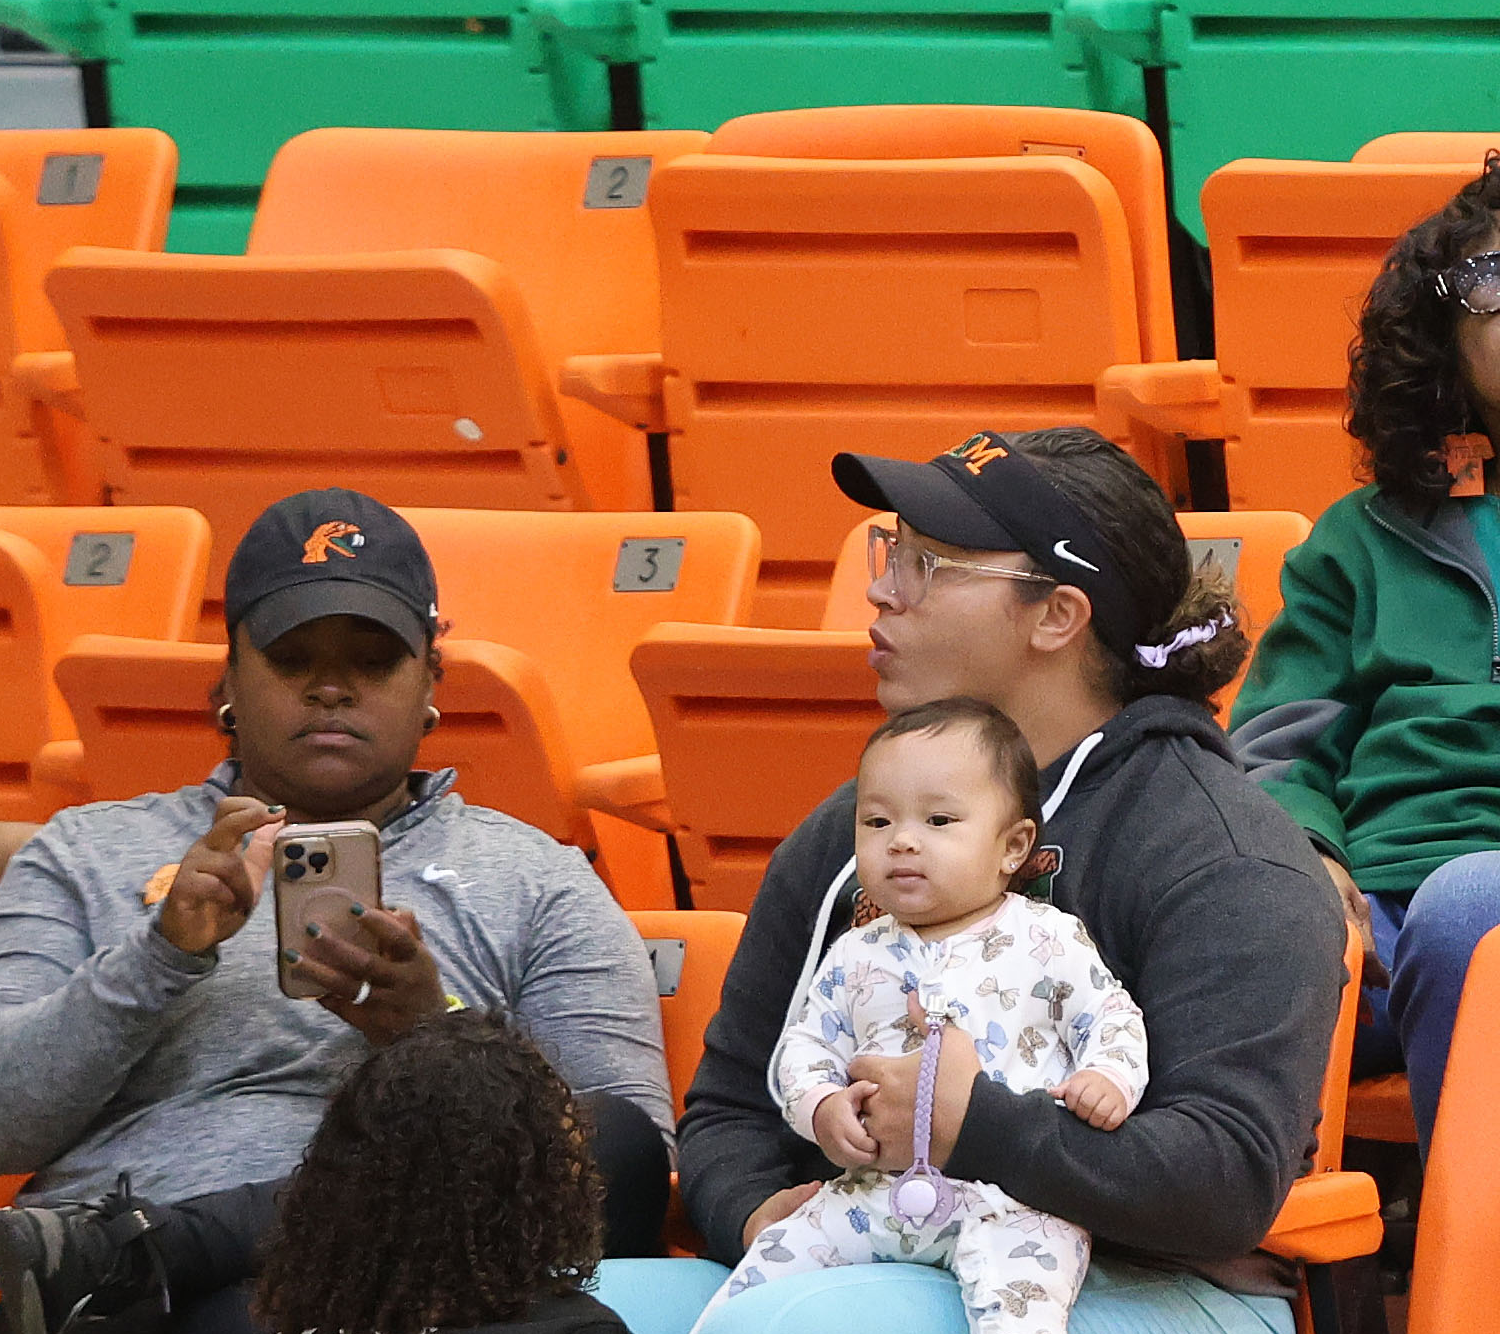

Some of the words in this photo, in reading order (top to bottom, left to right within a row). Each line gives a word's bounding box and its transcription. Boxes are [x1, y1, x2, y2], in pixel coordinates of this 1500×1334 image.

[608, 167, 630, 199] 2
[87, 543, 111, 576] 2
[638, 548, 660, 583] 3
